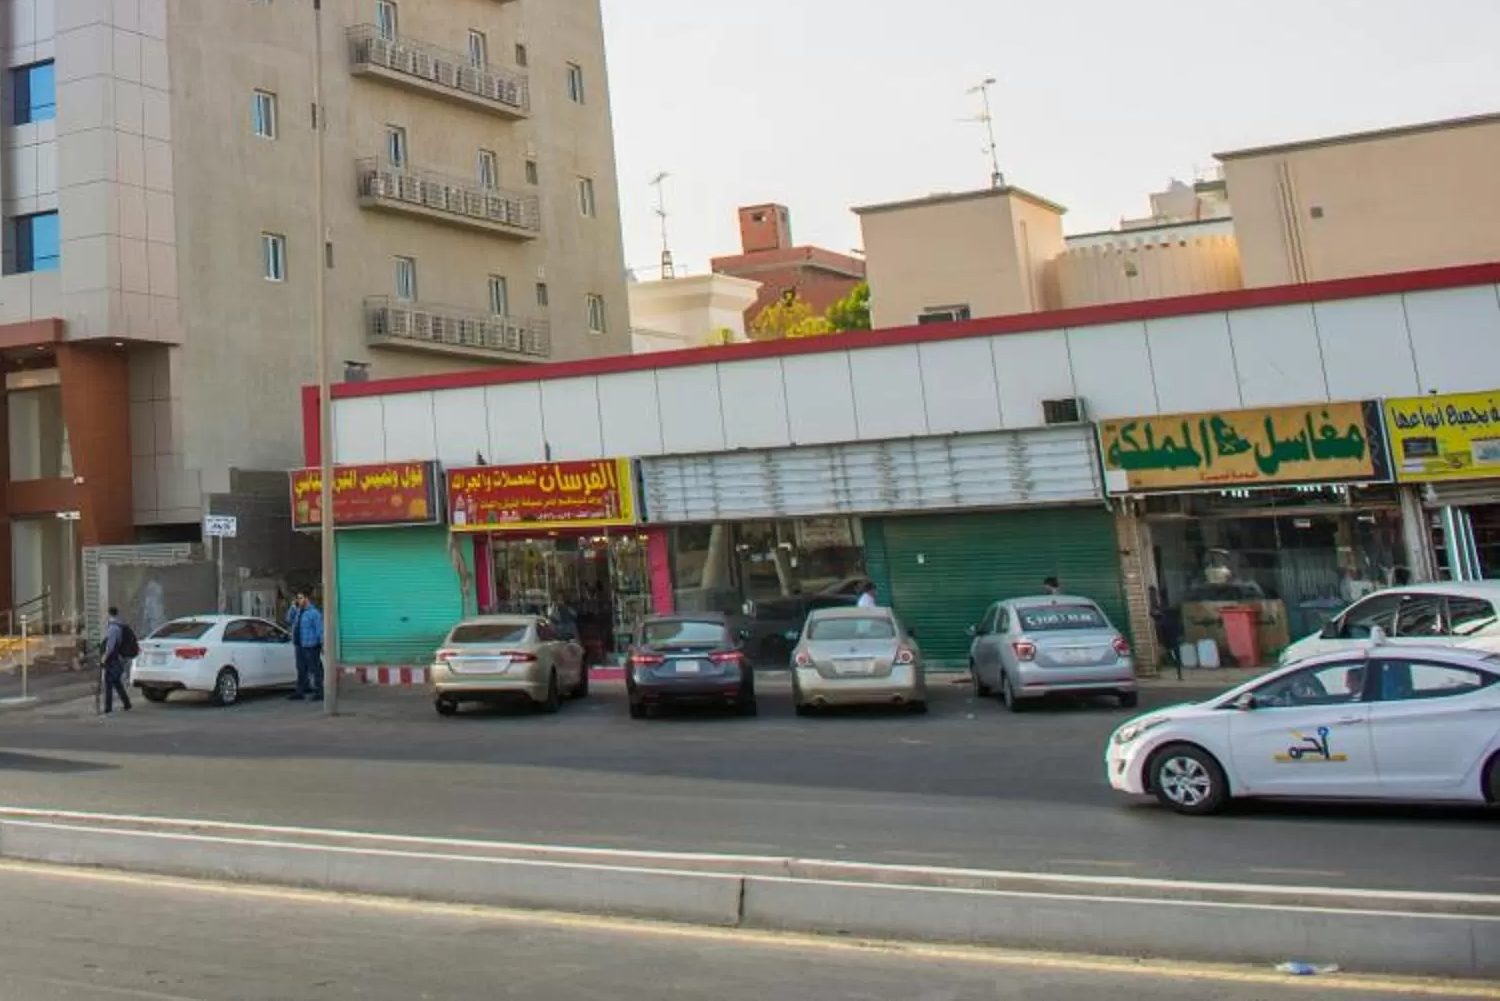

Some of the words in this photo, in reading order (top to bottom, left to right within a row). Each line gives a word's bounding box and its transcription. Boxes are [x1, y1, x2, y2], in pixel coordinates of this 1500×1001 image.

[1104, 417, 1213, 472] المملكة
[1254, 409, 1365, 476] مغاسل
[539, 462, 616, 496] الفرسان
